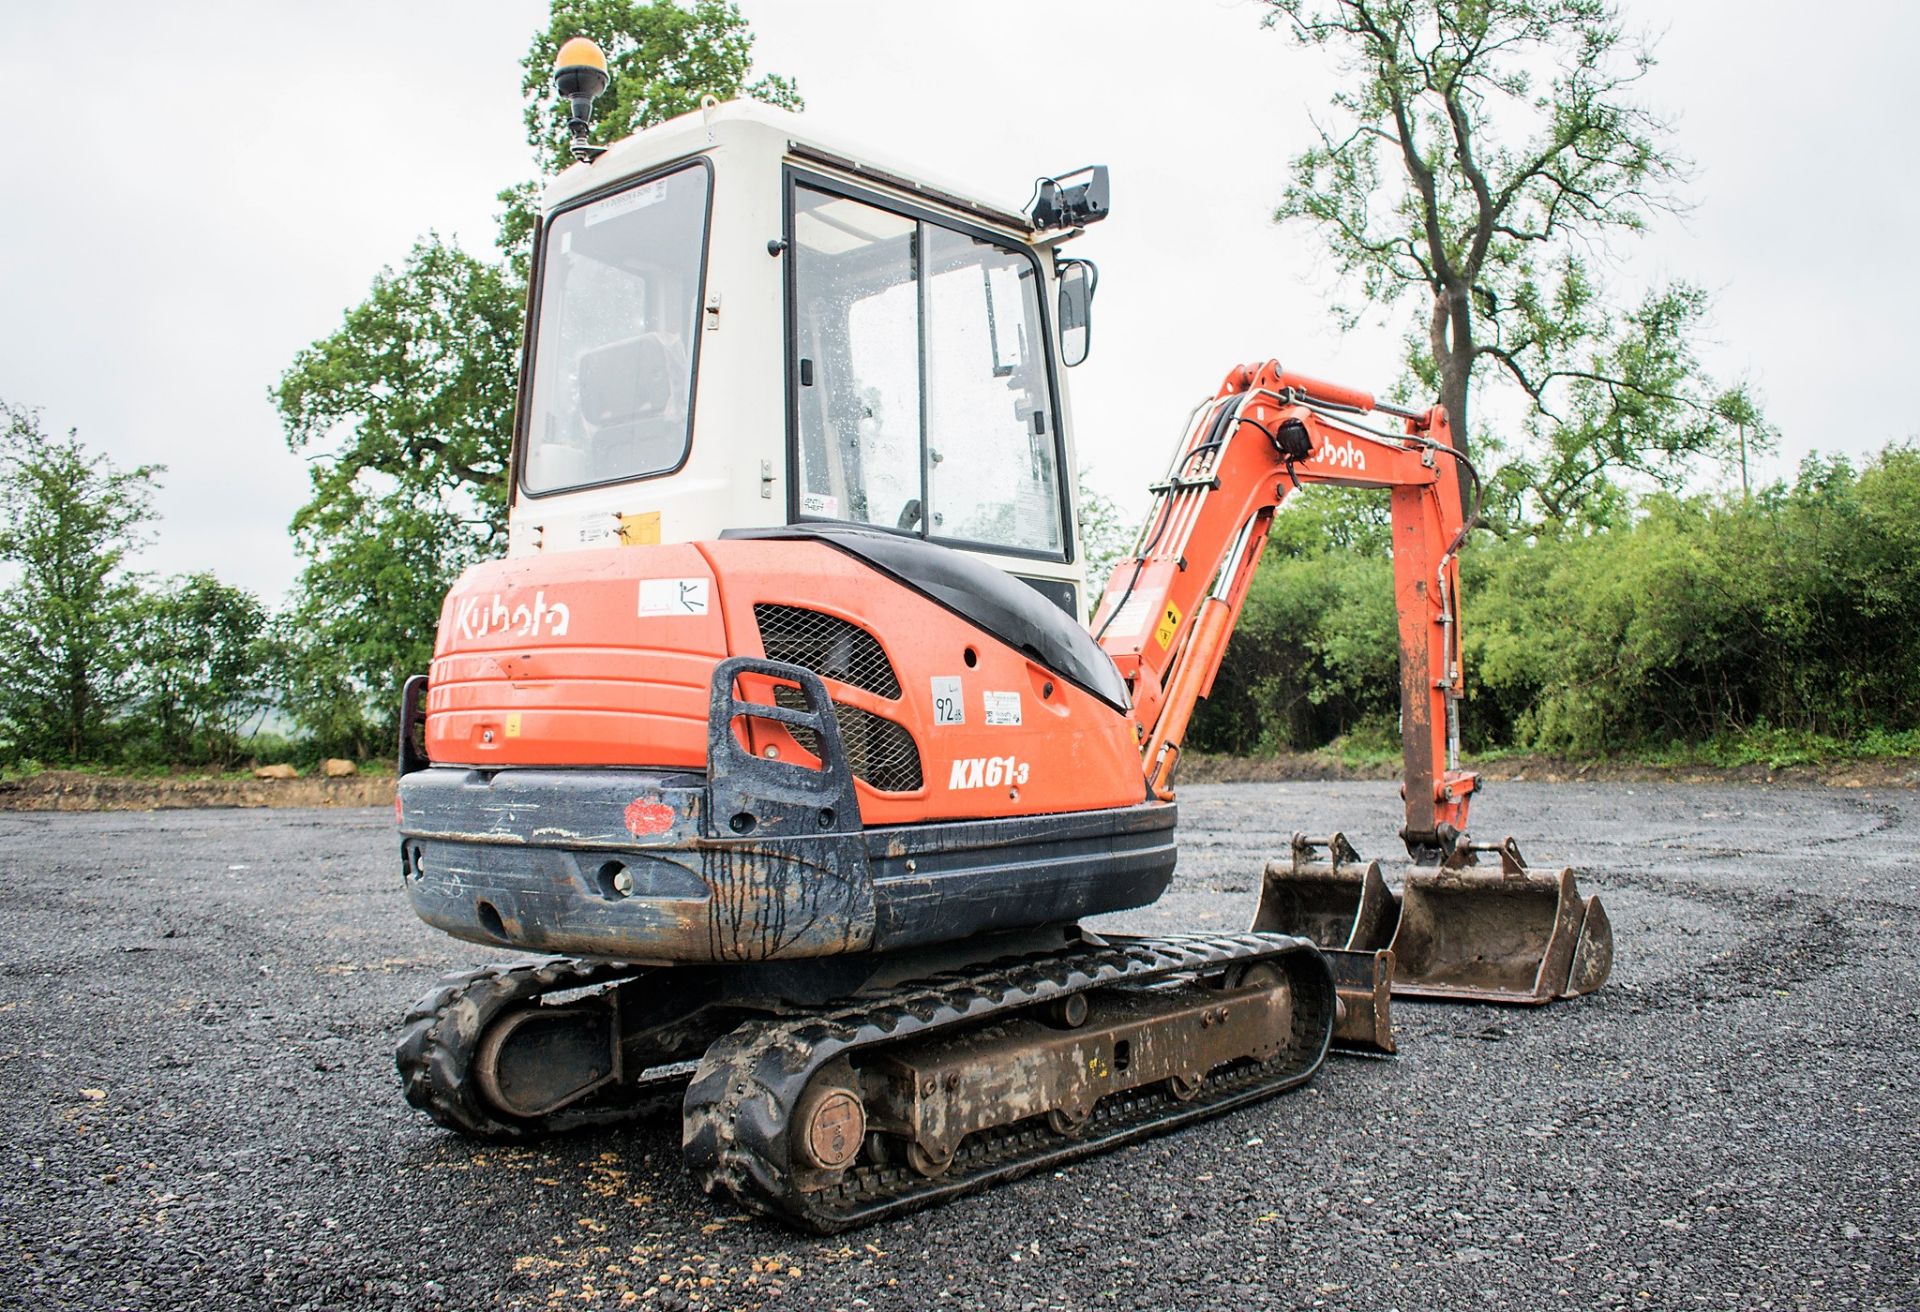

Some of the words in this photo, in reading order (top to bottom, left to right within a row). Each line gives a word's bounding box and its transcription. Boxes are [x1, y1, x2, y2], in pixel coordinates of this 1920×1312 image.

[1311, 435, 1366, 471] ubota
[456, 591, 570, 640] Kubota
[948, 755, 1030, 790] KX61-3
